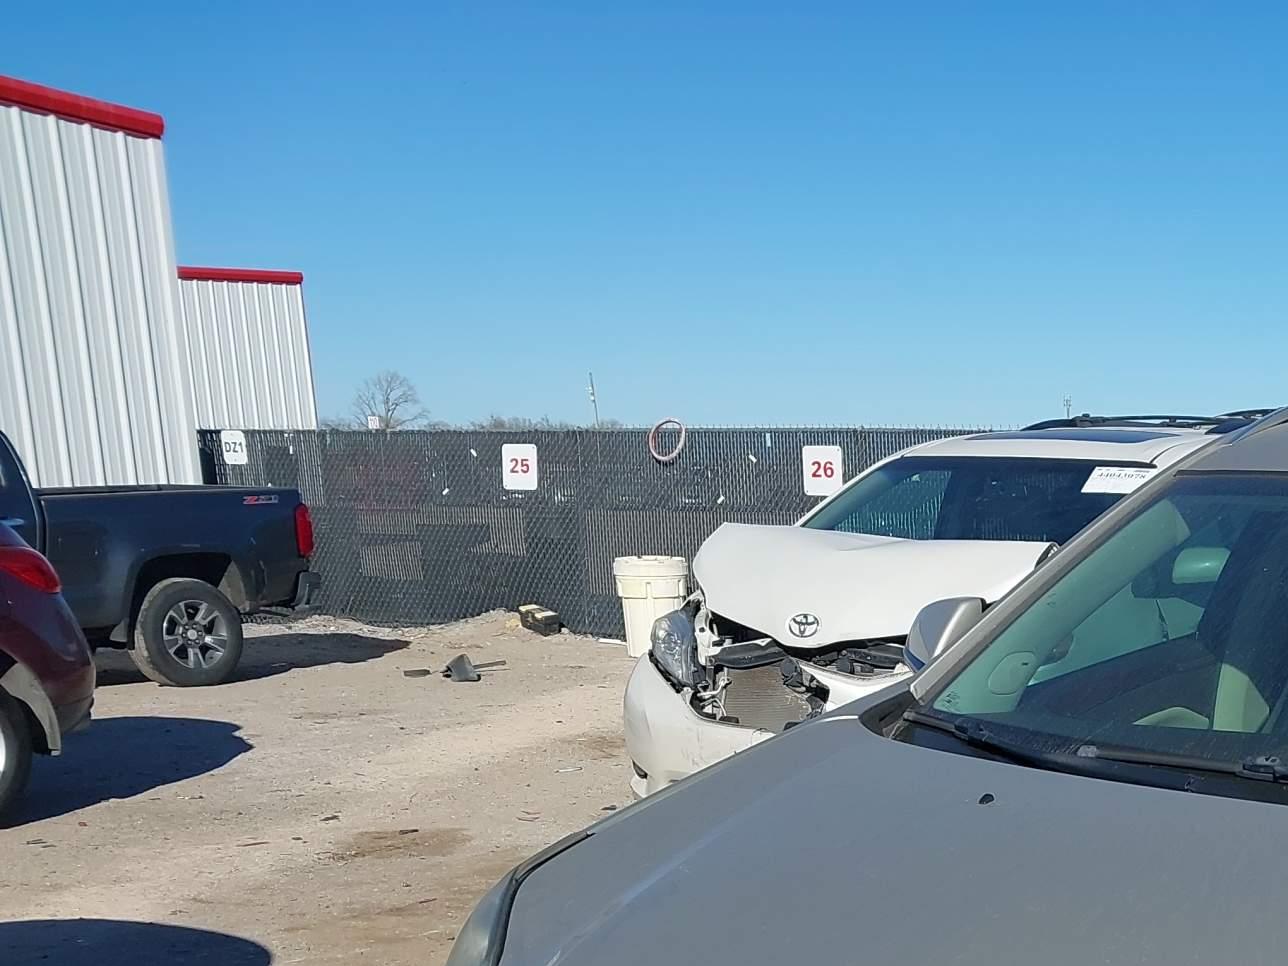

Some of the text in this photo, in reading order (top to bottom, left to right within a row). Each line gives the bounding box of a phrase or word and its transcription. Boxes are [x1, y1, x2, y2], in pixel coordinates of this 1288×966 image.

[224, 441, 244, 453] DZ1
[509, 458, 530, 474] 25
[811, 461, 835, 478] 26
